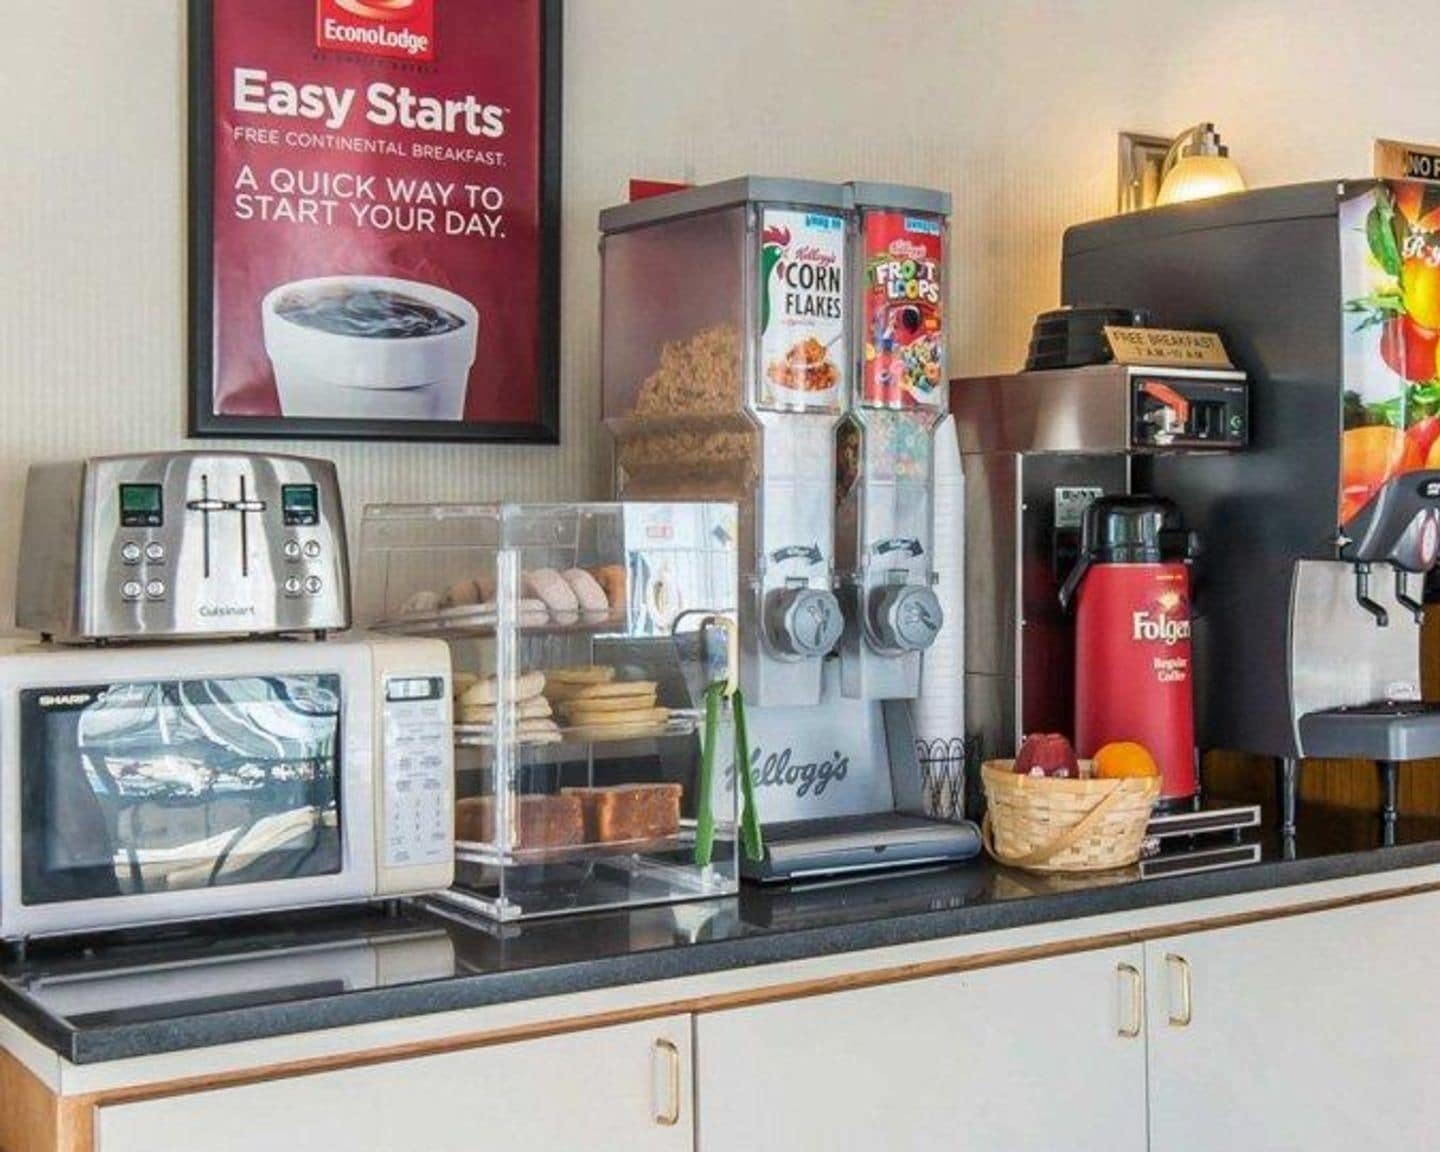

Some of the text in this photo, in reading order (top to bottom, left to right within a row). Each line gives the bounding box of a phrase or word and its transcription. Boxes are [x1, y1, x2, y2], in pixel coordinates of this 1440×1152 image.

[324, 18, 428, 54] EconoLodge
[233, 67, 505, 138] Easy Starts
[234, 126, 506, 167] FREE CONTINENTAL BREAKFAST.
[1408, 155, 1431, 177] NO
[235, 165, 504, 211] A QUICK WAY TO
[235, 193, 506, 238] START YOUR DAY.
[795, 245, 837, 267] Kellogg's
[785, 262, 841, 293] CORN
[887, 279, 940, 305] LOOPS
[785, 293, 841, 319] FLAKES
[1112, 331, 1214, 350] FREE BREAKFAST
[199, 603, 256, 617] Cuisinart
[39, 694, 90, 707] SHARP
